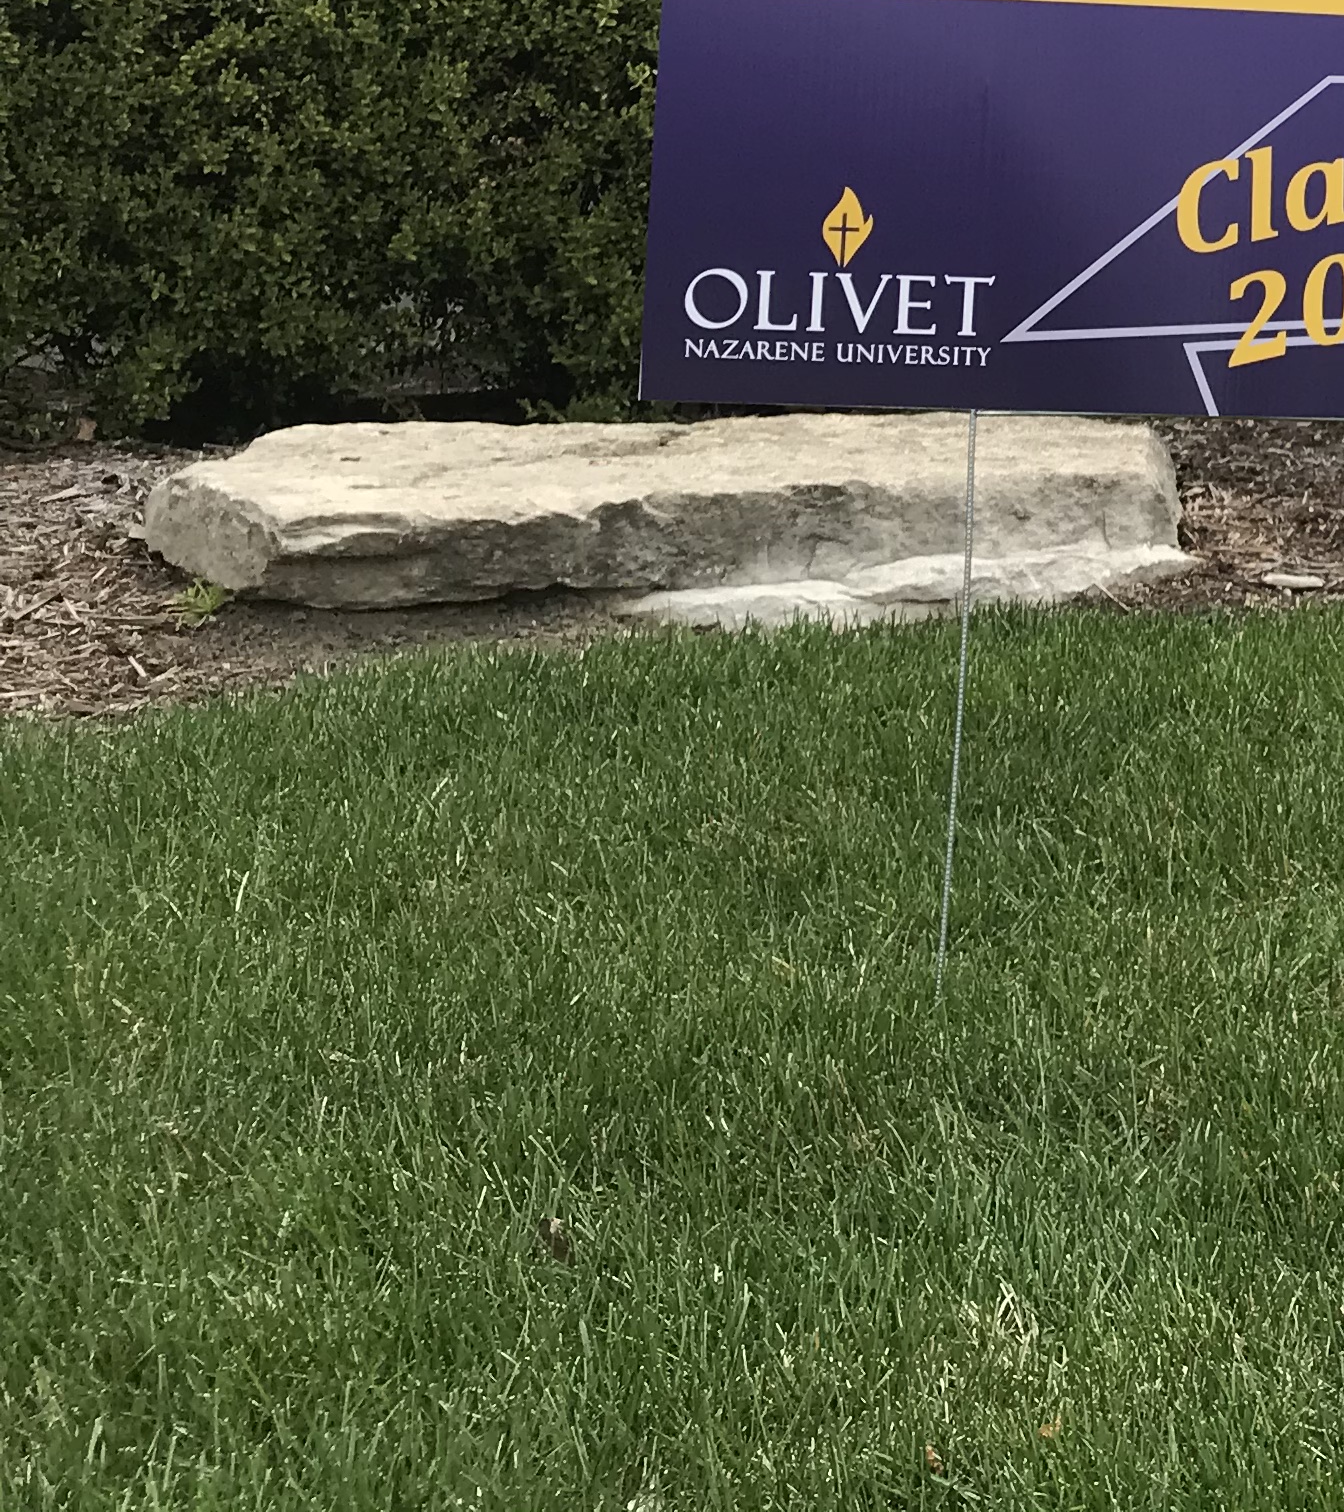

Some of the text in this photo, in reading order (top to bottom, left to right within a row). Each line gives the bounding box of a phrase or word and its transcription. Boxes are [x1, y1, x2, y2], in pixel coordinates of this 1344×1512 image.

[683, 267, 997, 338] OLIVET
[683, 337, 993, 368] NAZARENE UNIVERSITY
